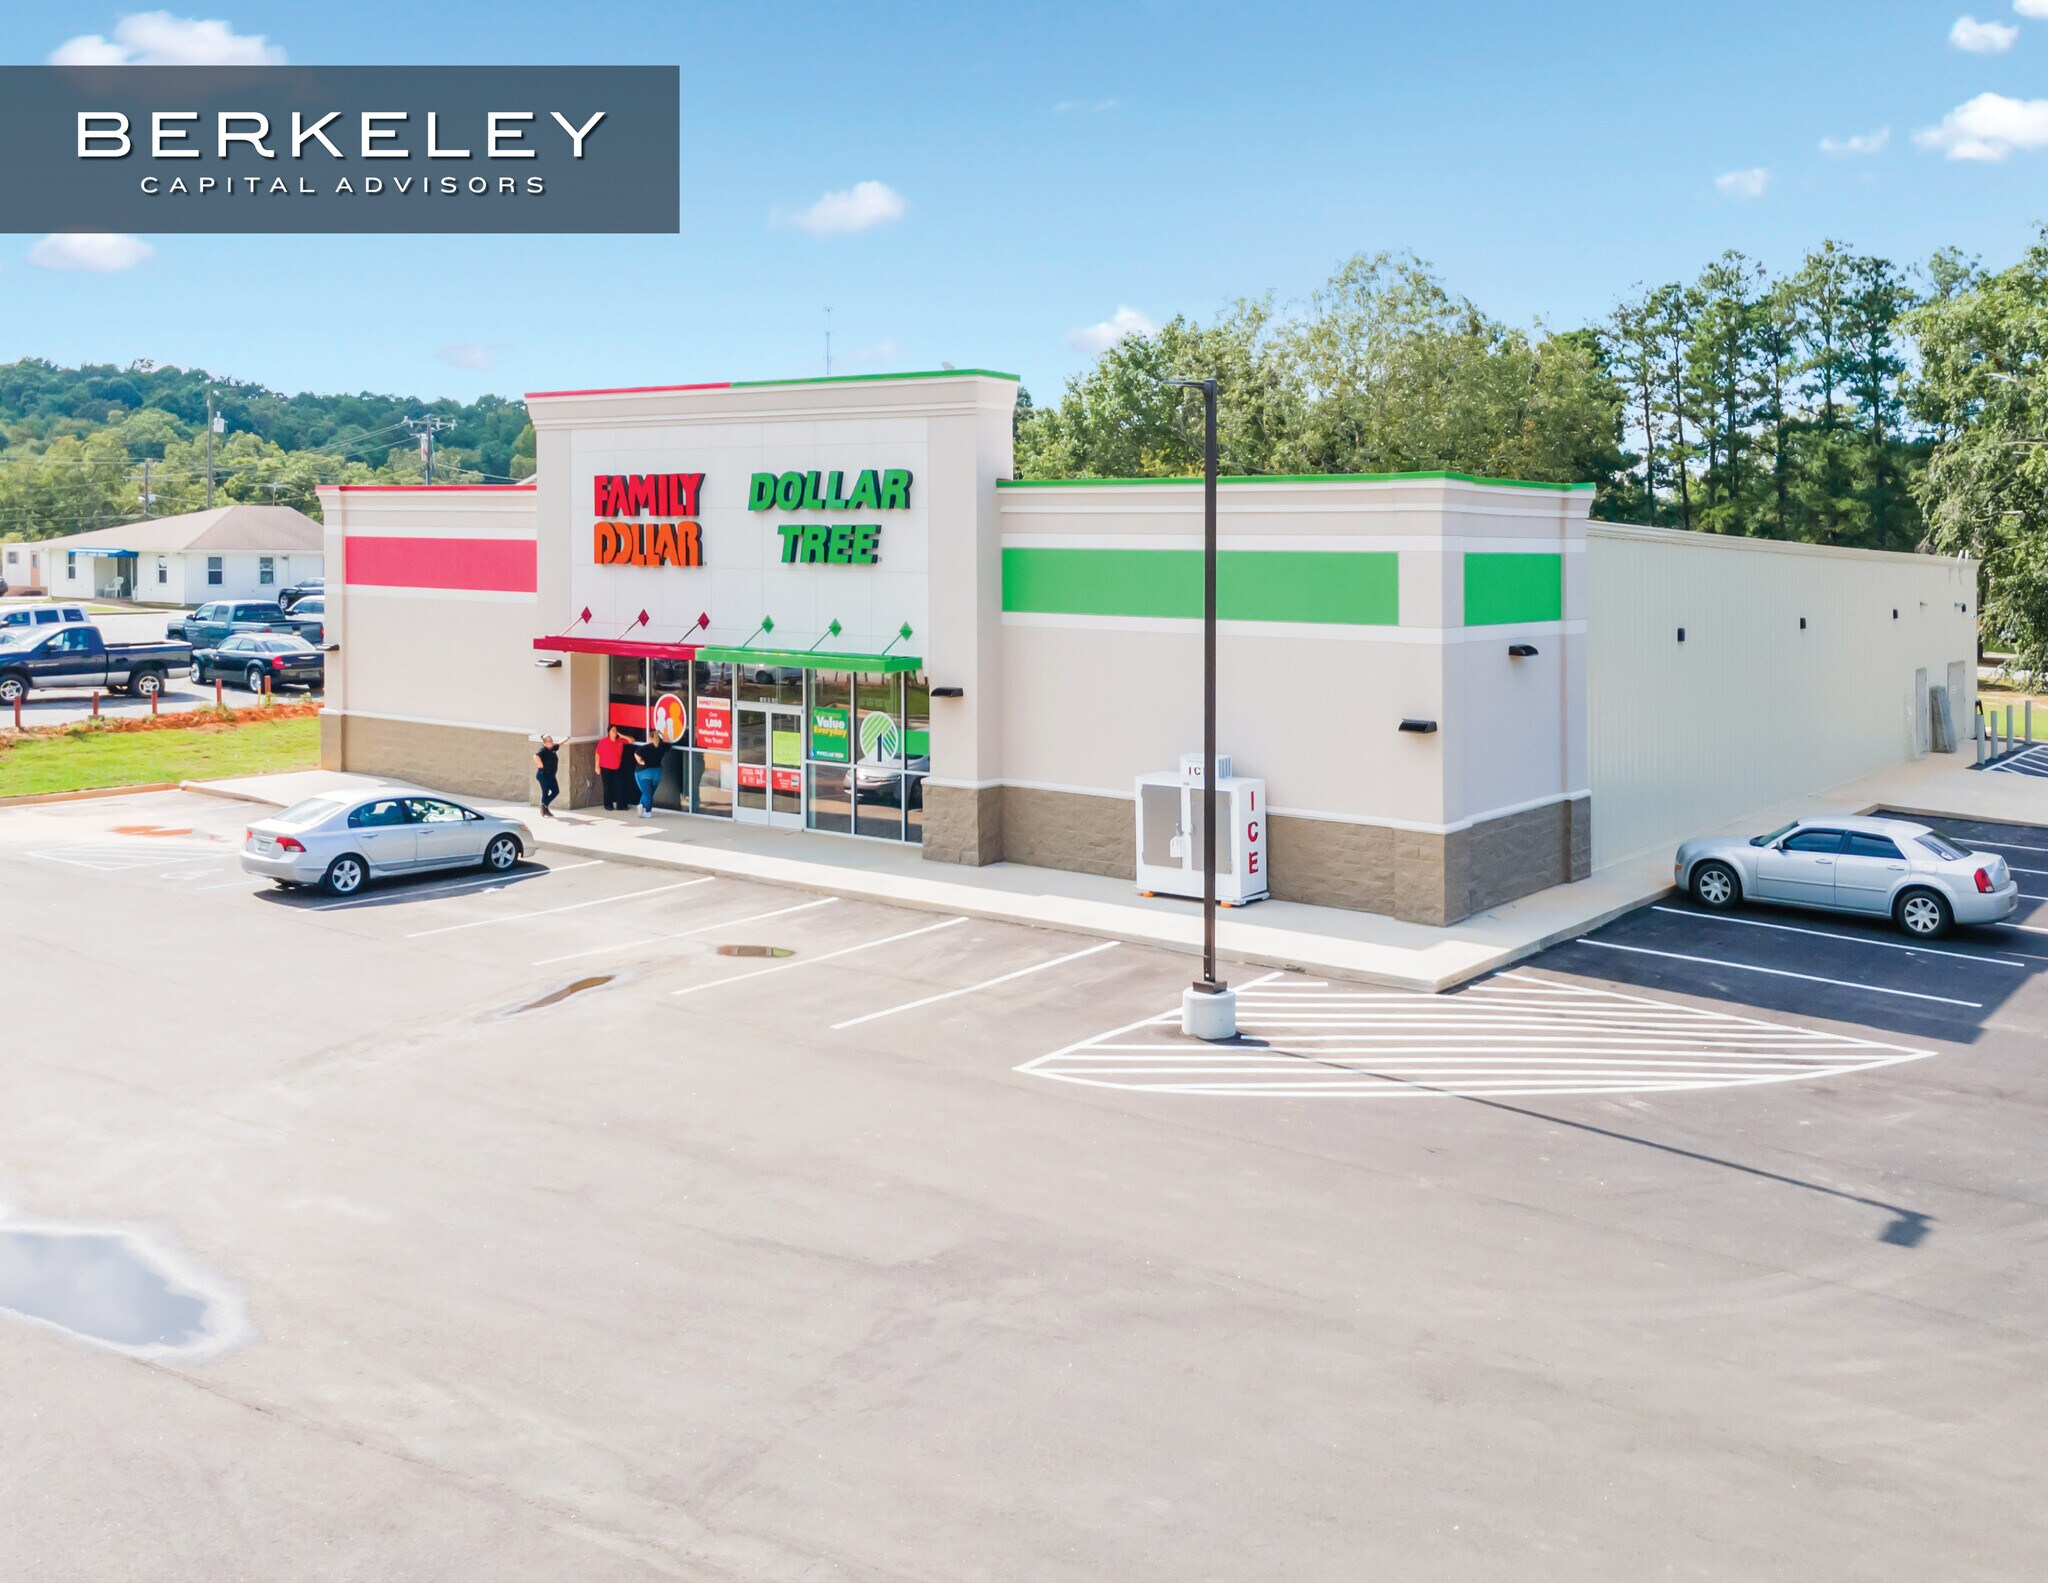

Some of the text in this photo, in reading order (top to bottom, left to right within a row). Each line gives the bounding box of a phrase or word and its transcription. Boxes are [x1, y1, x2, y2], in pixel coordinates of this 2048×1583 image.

[594, 473, 706, 517] FAMILY
[748, 469, 914, 511] DOLLAR
[593, 521, 703, 567] DOLLAR
[777, 524, 882, 564] TREE
[705, 718, 722, 728] 1,000
[813, 725, 847, 738] Everyday
[816, 716, 846, 730] Value
[1247, 791, 1259, 874] ICE
